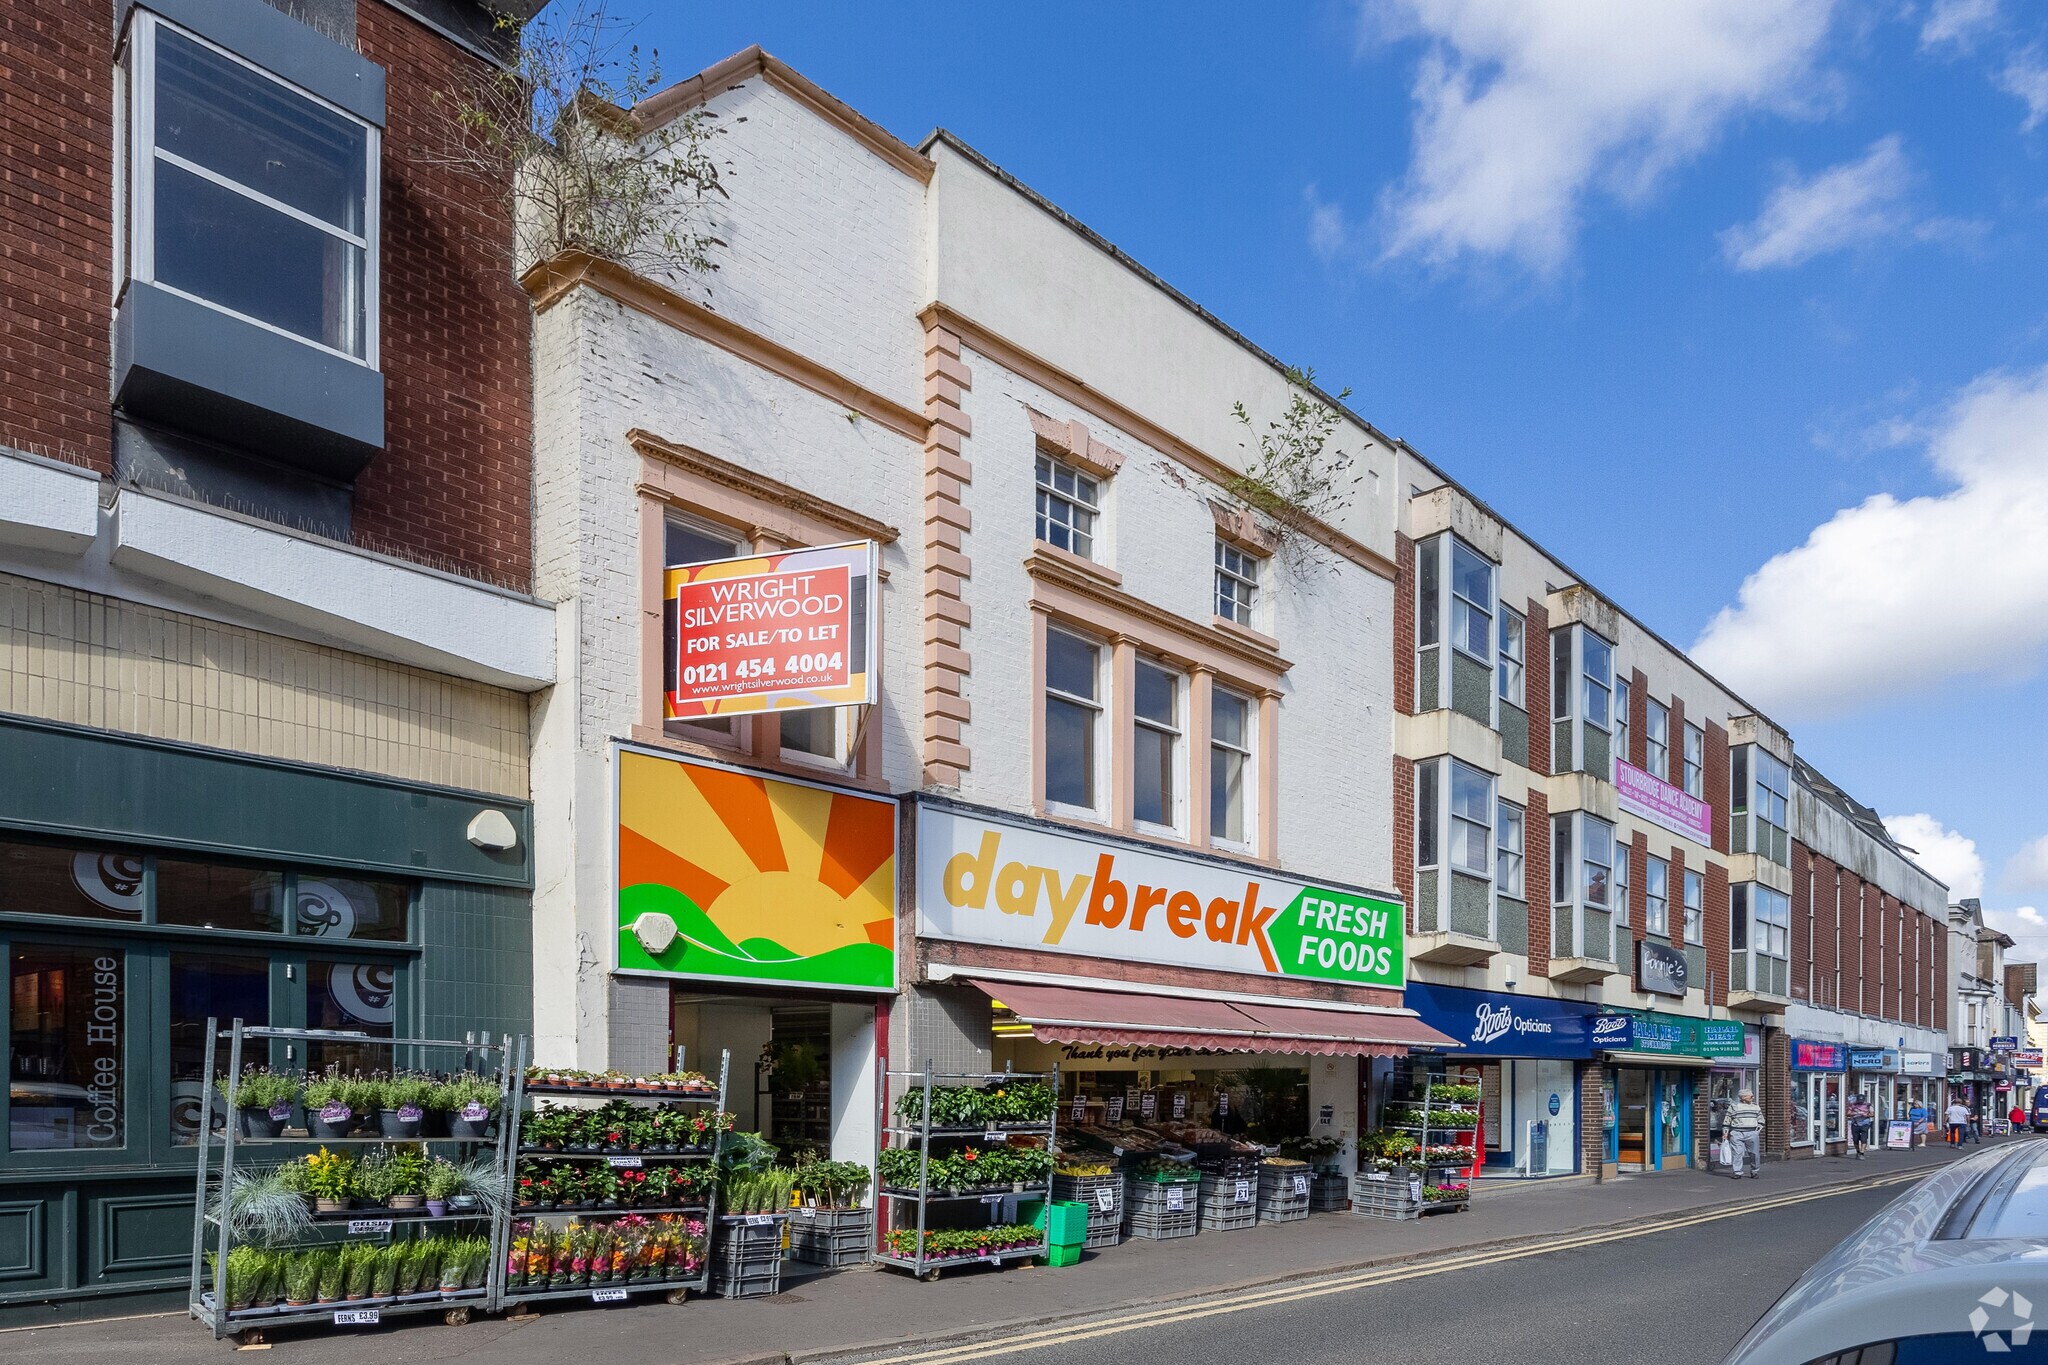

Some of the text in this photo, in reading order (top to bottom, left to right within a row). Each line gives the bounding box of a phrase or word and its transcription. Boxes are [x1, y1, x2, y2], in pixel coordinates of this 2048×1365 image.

[711, 575, 816, 603] WRIGHT
[684, 594, 843, 628] SILVERWOOD
[687, 624, 840, 654] FOR SALE/TO LET
[683, 651, 843, 685] 0121 454 4004
[692, 672, 833, 694] www.wrightsilverwood.co.uk
[1660, 783, 1679, 808] DANCE
[943, 830, 1281, 973] daybreak
[1298, 896, 1388, 940] FRESH
[1297, 935, 1392, 976] FOODS
[1471, 1002, 1552, 1044] Boots Opticians
[1592, 1017, 1627, 1034] Boots
[1660, 1024, 1682, 1042] MEAT
[87, 956, 118, 1142] Coffee House
[1061, 1045, 1104, 1060] Thank
[1106, 1048, 1131, 1062] you
[1131, 1046, 1155, 1062] for
[1157, 1046, 1192, 1060] your
[1592, 1036, 1627, 1044] Opticians
[1237, 1189, 1247, 1198] £1
[337, 1311, 378, 1322] FERNS £3.99
